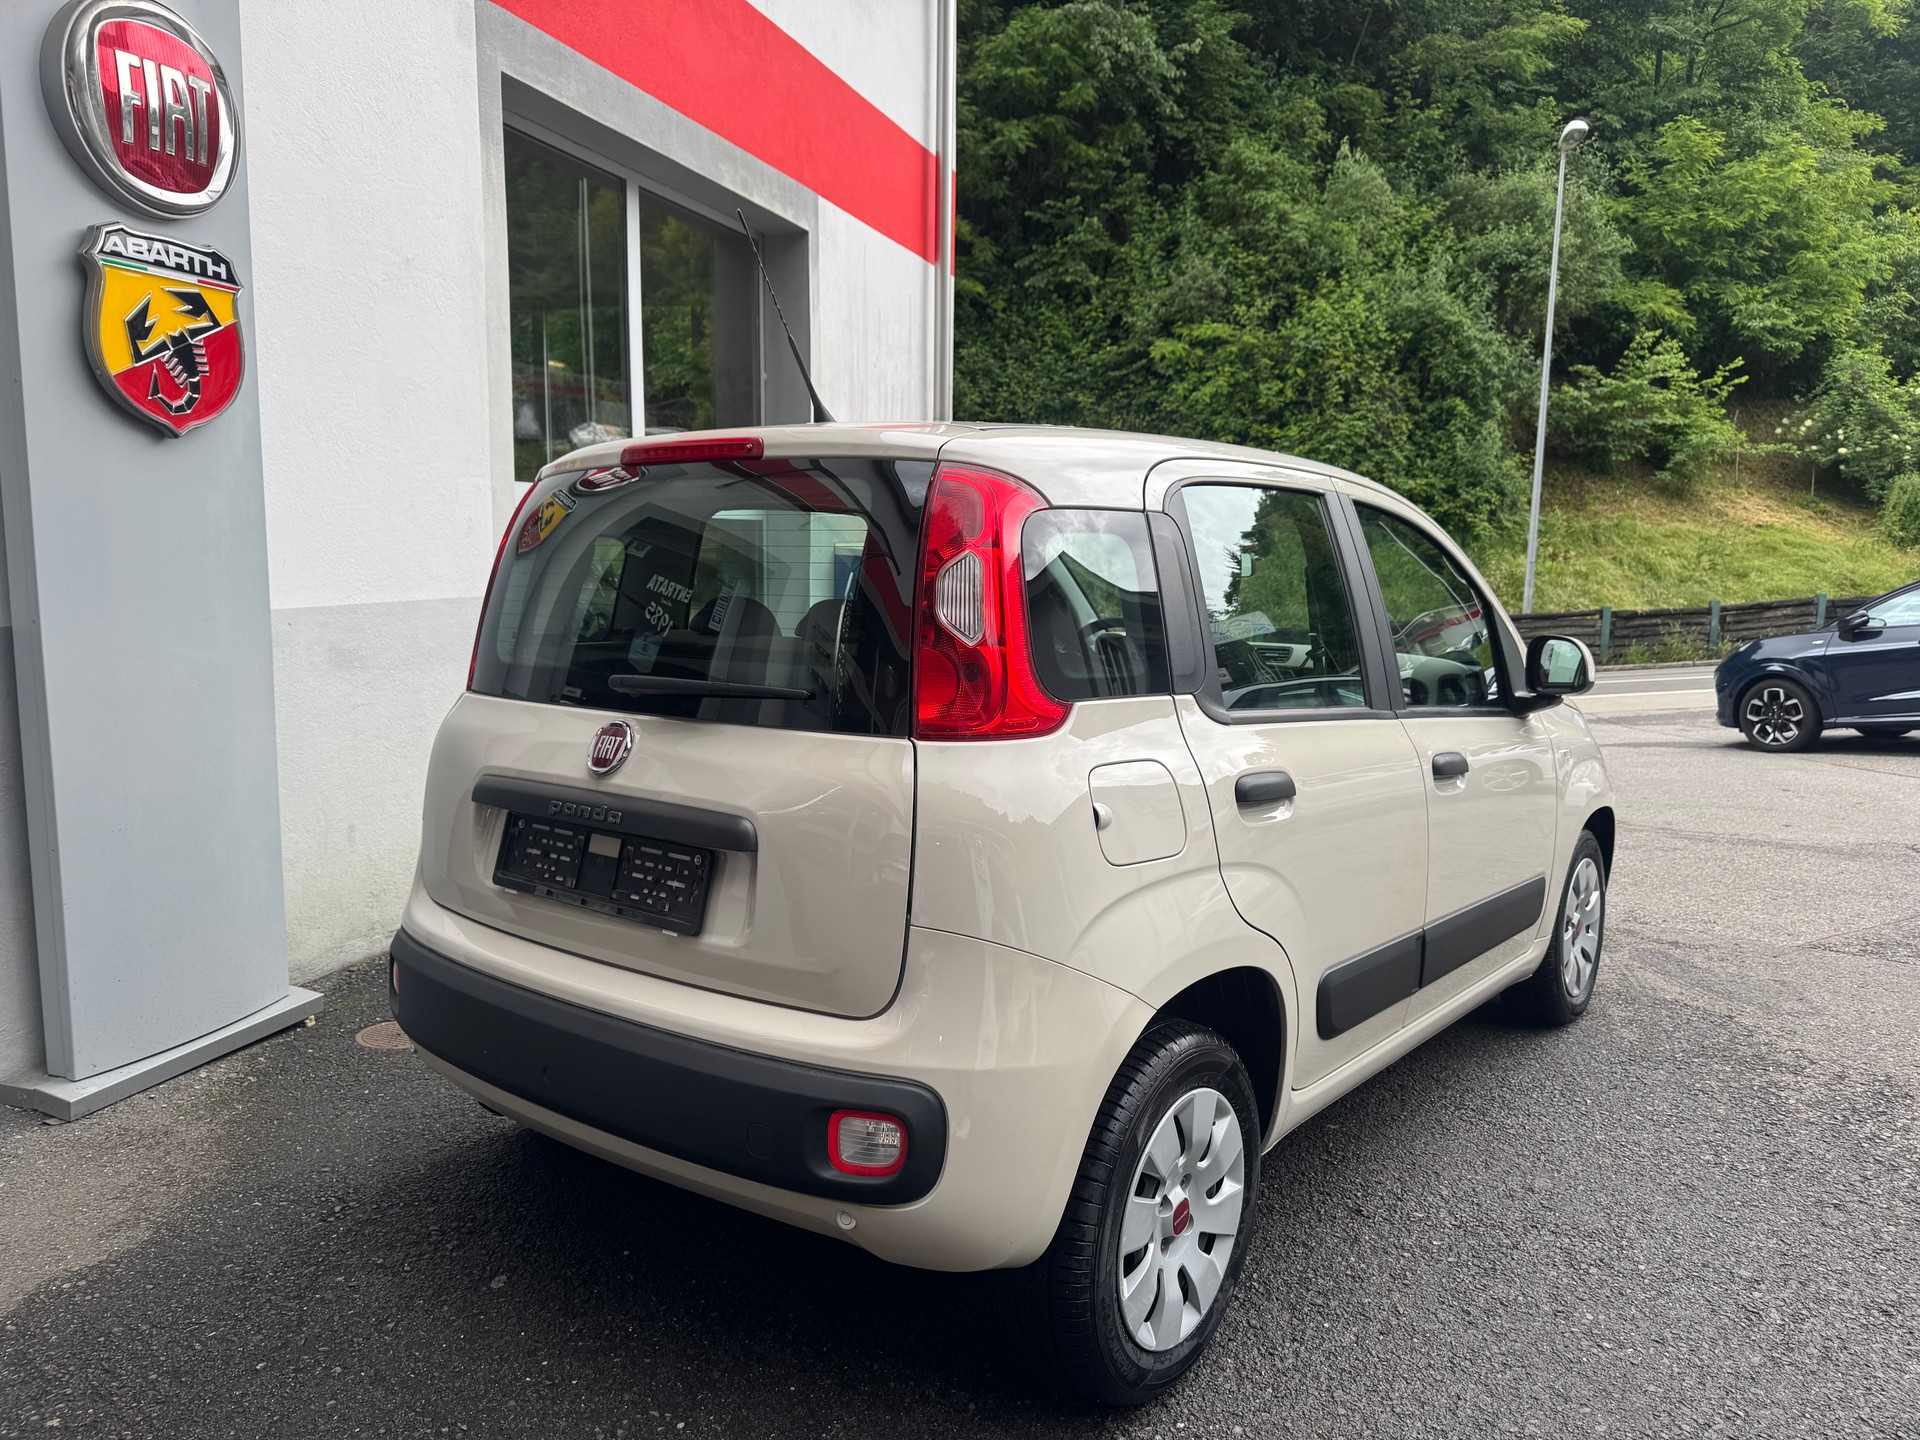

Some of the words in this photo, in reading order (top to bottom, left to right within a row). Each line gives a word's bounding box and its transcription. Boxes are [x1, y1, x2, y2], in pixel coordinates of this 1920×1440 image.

[114, 48, 211, 165] FIAT
[103, 235, 227, 280] ABARTH
[598, 735, 623, 760] FIAT
[549, 801, 622, 823] panda
